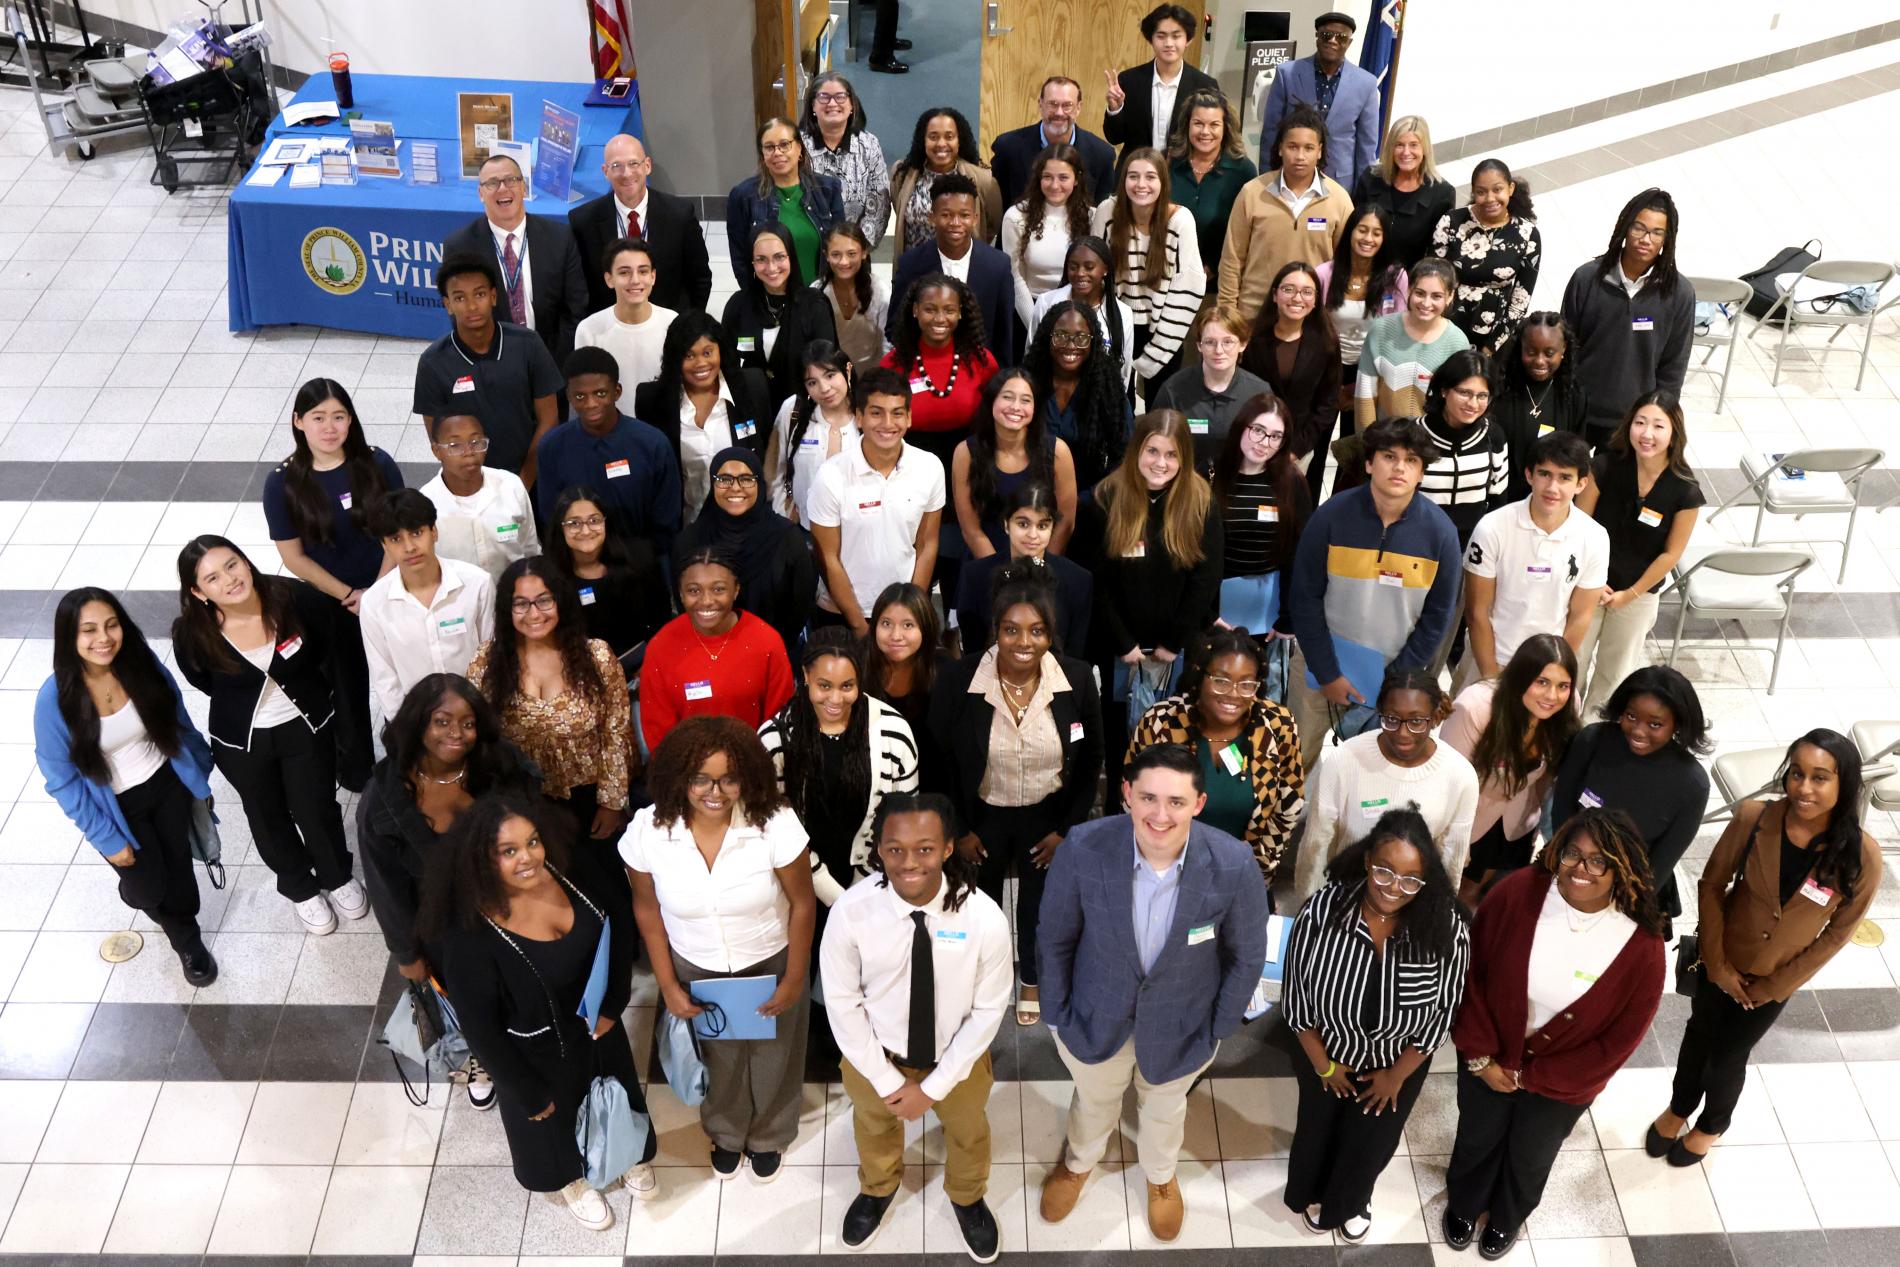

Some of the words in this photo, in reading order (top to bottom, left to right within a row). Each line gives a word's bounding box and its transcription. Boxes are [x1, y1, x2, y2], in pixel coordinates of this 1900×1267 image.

[1256, 48, 1287, 57] QUIET
[308, 229, 330, 242] PRINCE
[369, 231, 443, 263] PRIN
[372, 258, 438, 289] WIL
[396, 290, 444, 309] Huma
[1468, 542, 1483, 565] 3
